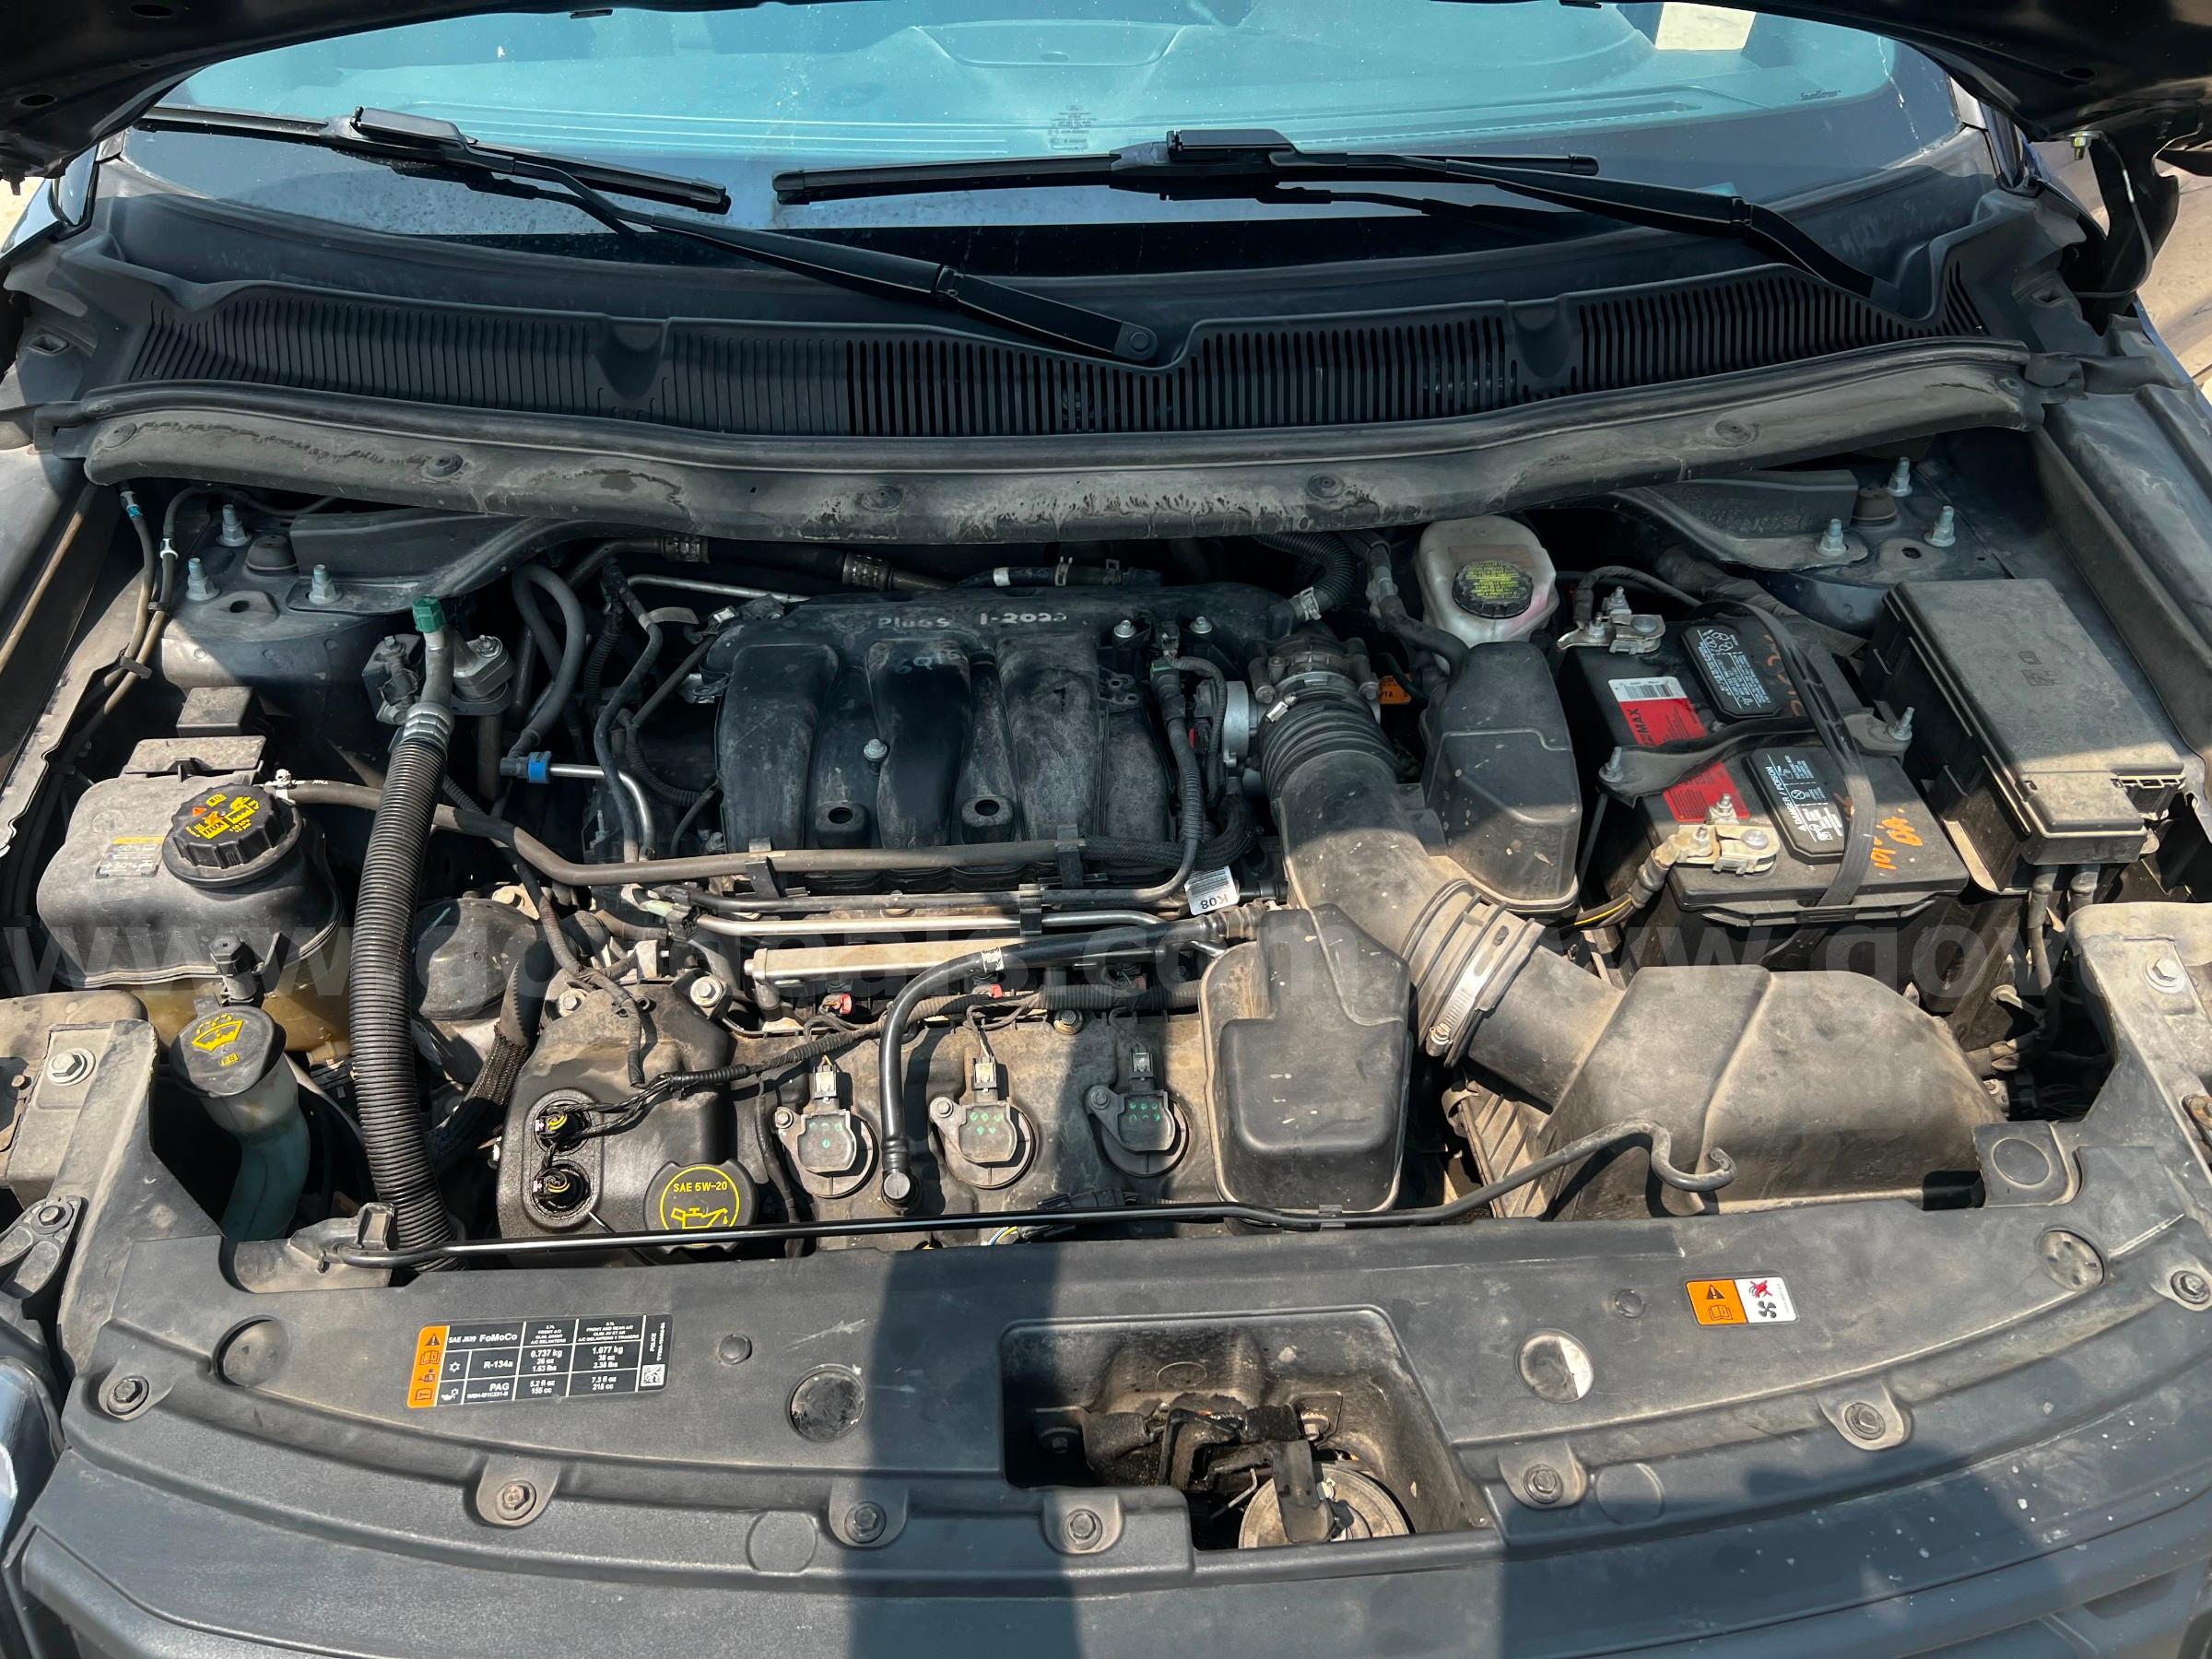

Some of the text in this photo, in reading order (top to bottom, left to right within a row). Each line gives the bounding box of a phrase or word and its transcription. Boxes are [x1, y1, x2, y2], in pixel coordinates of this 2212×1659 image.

[1765, 766, 1785, 791] POISON
[1782, 796, 1805, 825] DANGER
[1200, 893, 1229, 910] K08
[673, 1182, 728, 1193] SAE 5W-20
[479, 1333, 518, 1343] FoMoCo
[649, 1332, 657, 1352] POLICE
[530, 1348, 563, 1359] 0.737 kg
[592, 1346, 624, 1355] 1.077 kg
[483, 1359, 514, 1369] R-134a
[532, 1364, 547, 1372] 1.63
[488, 1382, 510, 1392] PAG
